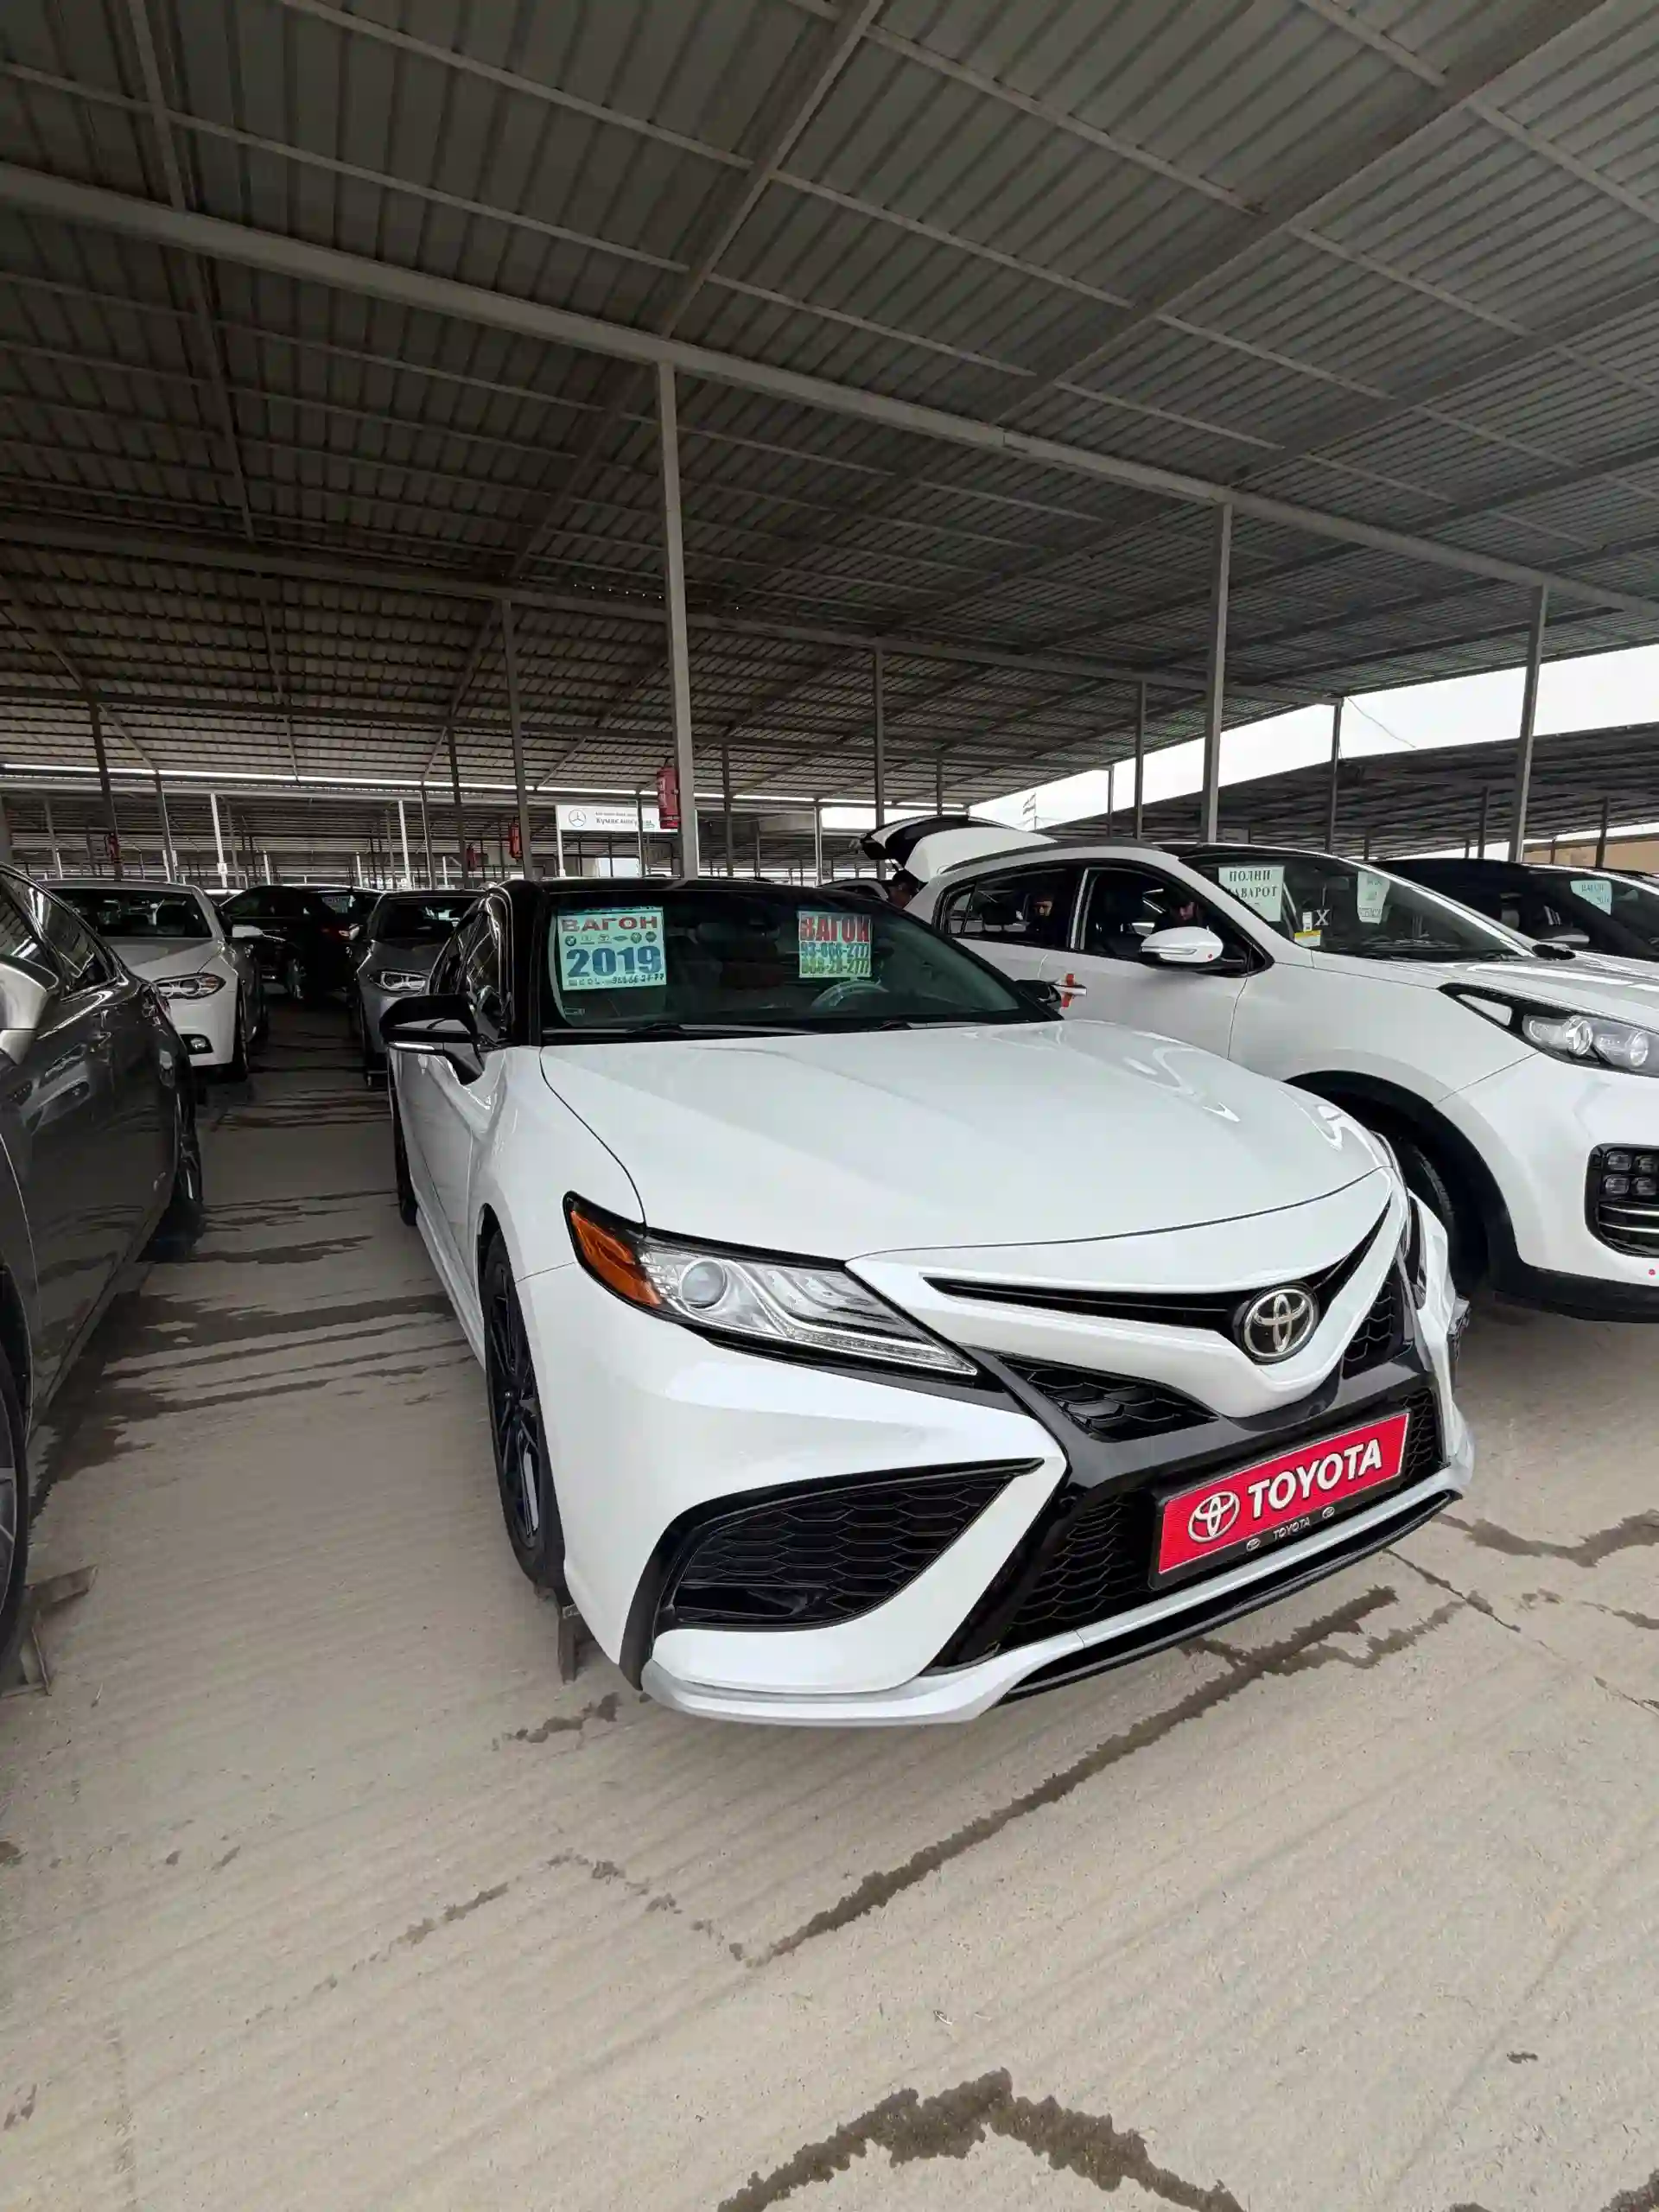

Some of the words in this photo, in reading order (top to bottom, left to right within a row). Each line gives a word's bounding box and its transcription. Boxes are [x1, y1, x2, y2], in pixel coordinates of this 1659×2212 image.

[1230, 869, 1271, 882] ПОЛНИ
[1227, 886, 1277, 899] АВАРОТ
[562, 916, 658, 932] ВАГОН
[800, 916, 869, 943] ВАГОН
[566, 945, 662, 977] 2019
[1248, 1438, 1382, 1519] TOYOTA
[1273, 1516, 1311, 1541] TOYOTA
